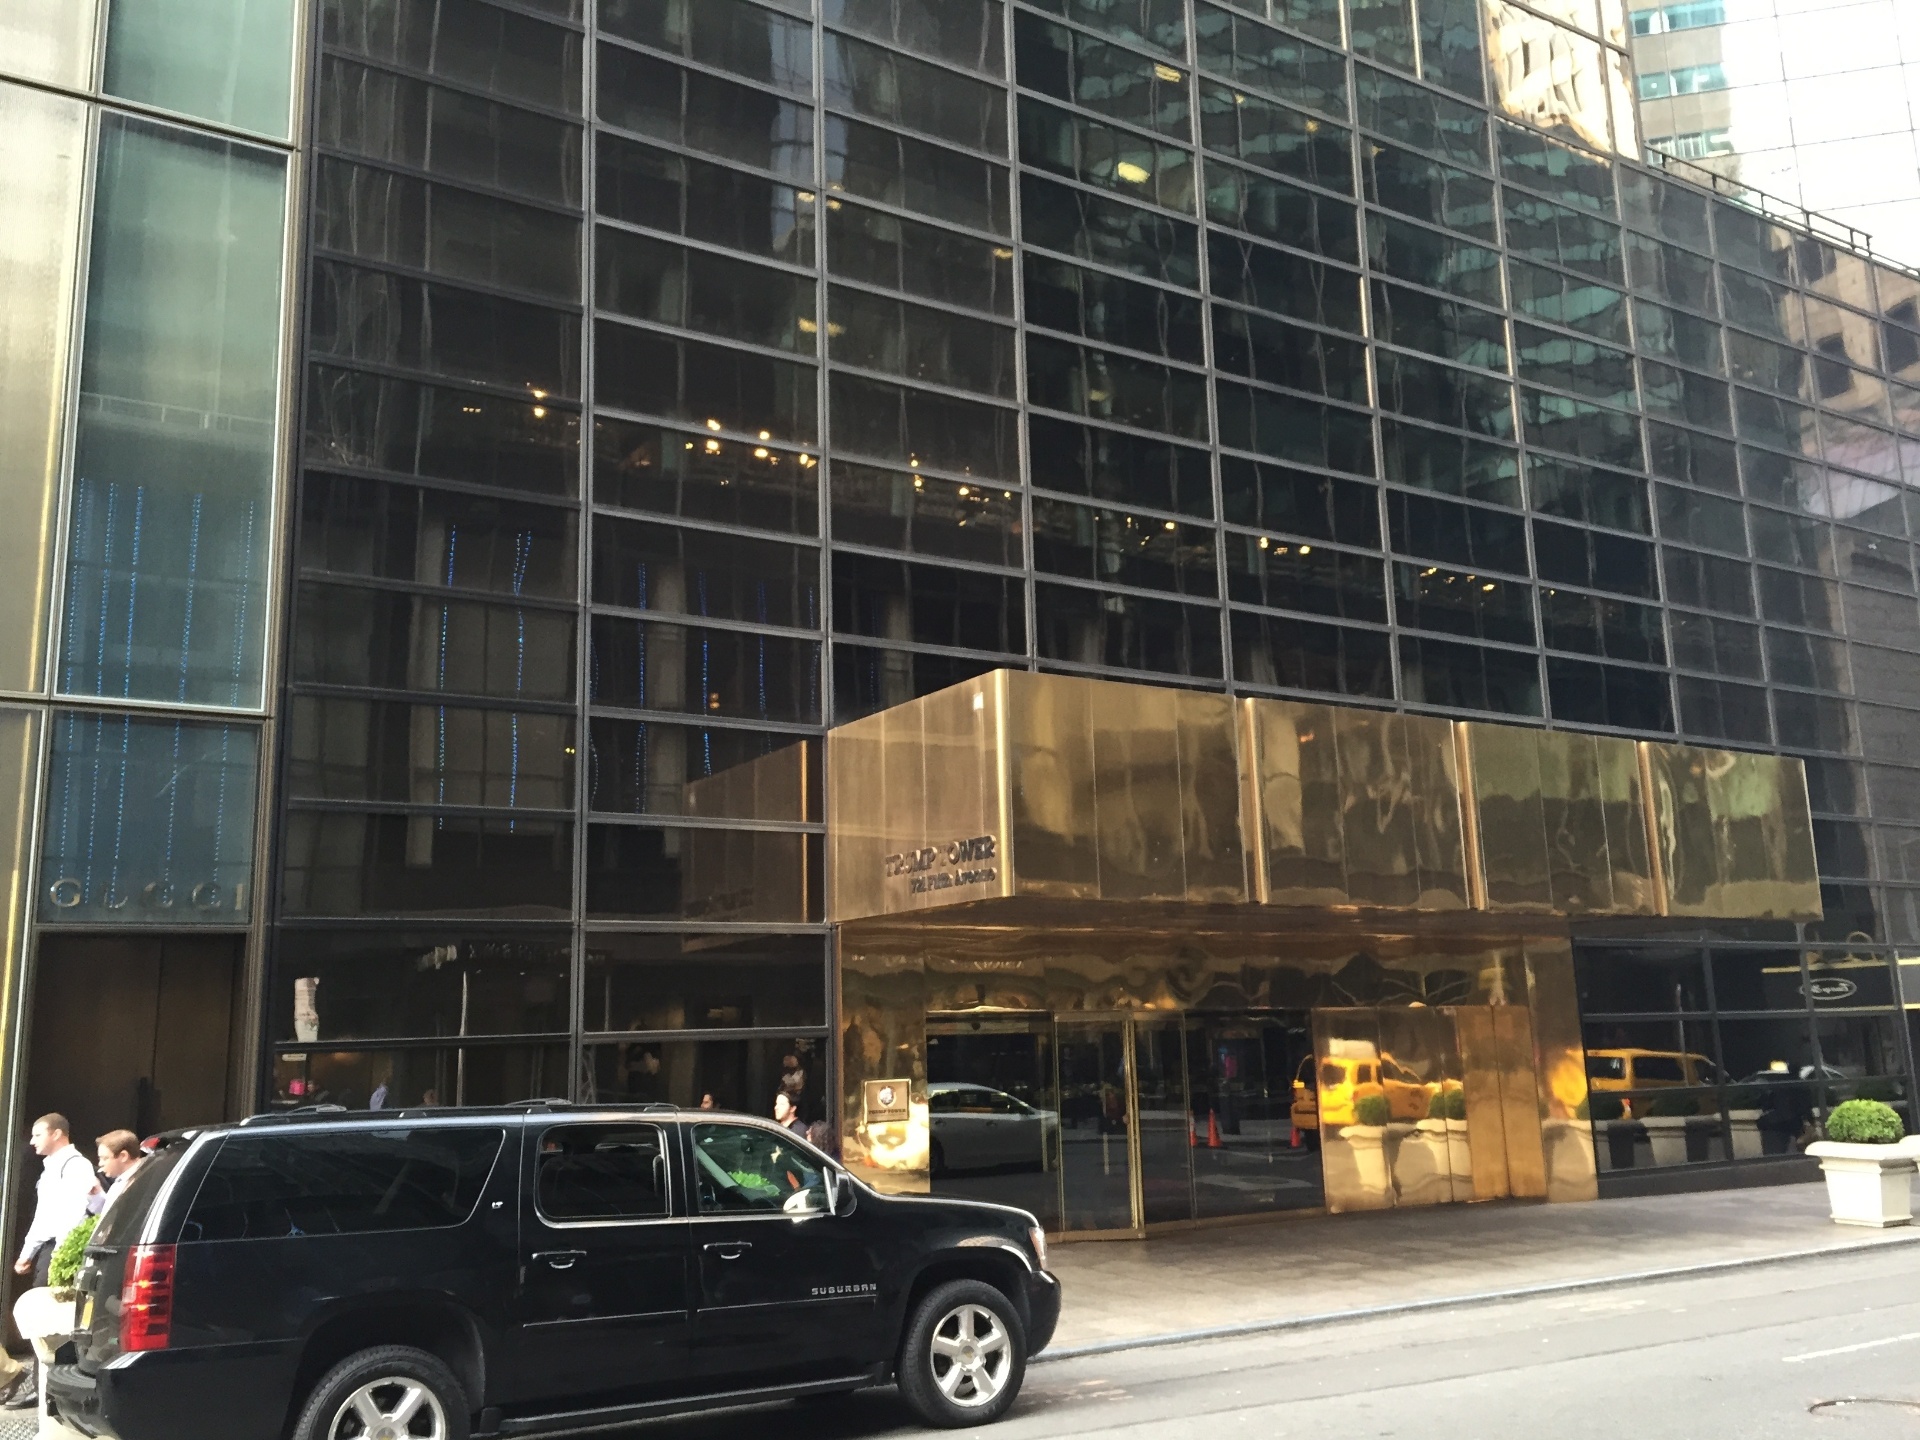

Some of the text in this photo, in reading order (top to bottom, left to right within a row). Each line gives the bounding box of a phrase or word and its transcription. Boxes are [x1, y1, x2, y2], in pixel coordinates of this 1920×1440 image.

[885, 834, 996, 877] TRUMP TOWER
[50, 877, 244, 911] GUCCI
[811, 1283, 877, 1296] SUBURBAN
